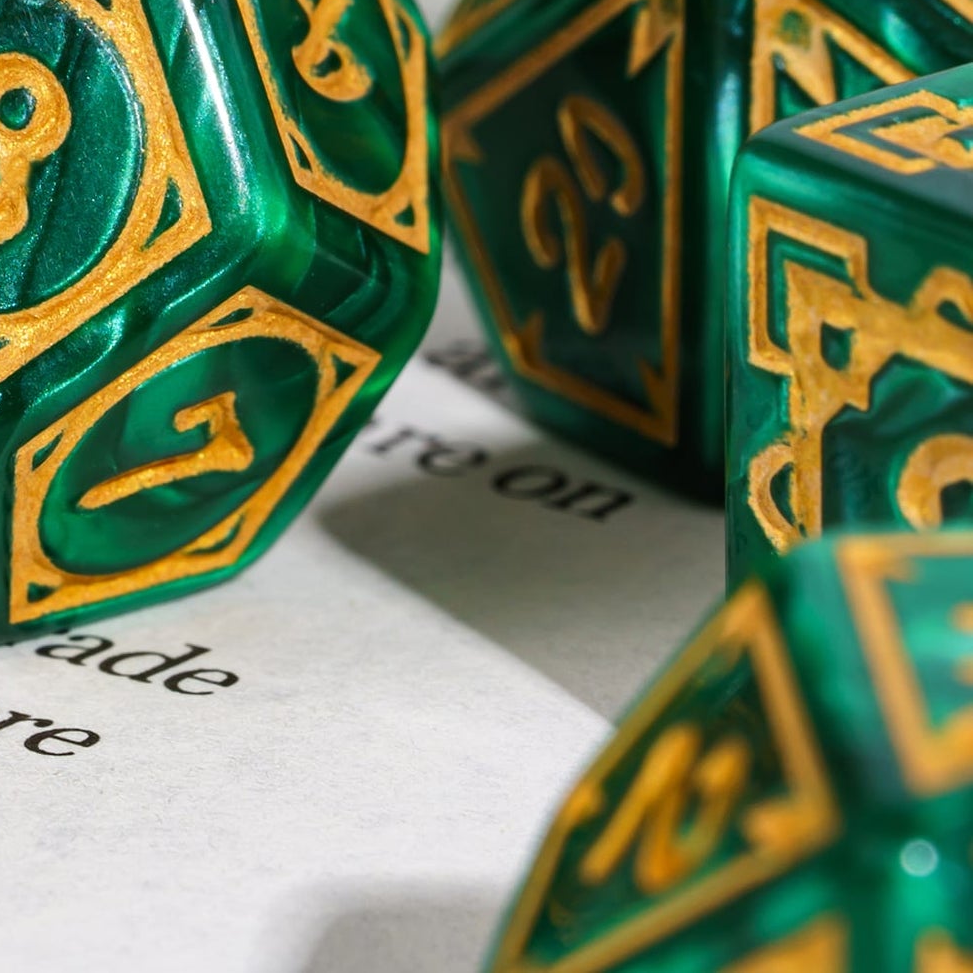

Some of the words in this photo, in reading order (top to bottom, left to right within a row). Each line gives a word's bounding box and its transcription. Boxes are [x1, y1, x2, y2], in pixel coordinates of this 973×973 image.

[519, 91, 646, 338] 20
[77, 391, 255, 511] 7
[365, 419, 488, 477] re
[490, 463, 635, 523] on
[32, 628, 240, 695] ade
